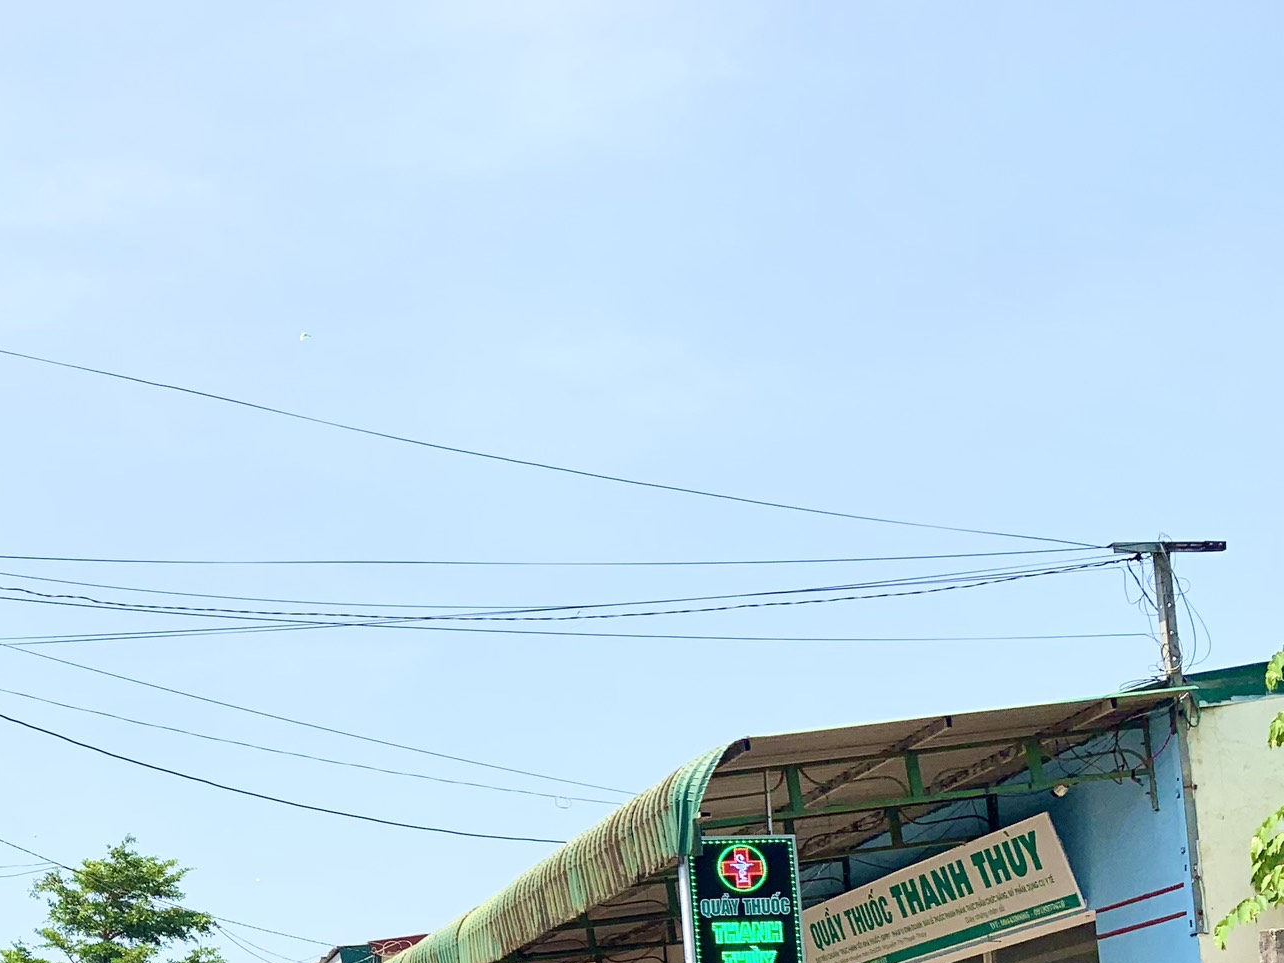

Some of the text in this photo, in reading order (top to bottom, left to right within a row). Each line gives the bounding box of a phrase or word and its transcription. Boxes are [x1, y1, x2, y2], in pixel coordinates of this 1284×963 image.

[700, 891, 791, 918] QUẦY THUỐC
[809, 907, 846, 951] QUẦY
[844, 889, 893, 937] THUỐC
[889, 859, 975, 919] THANH
[971, 831, 1043, 888] THÙY
[711, 920, 784, 945] THANH
